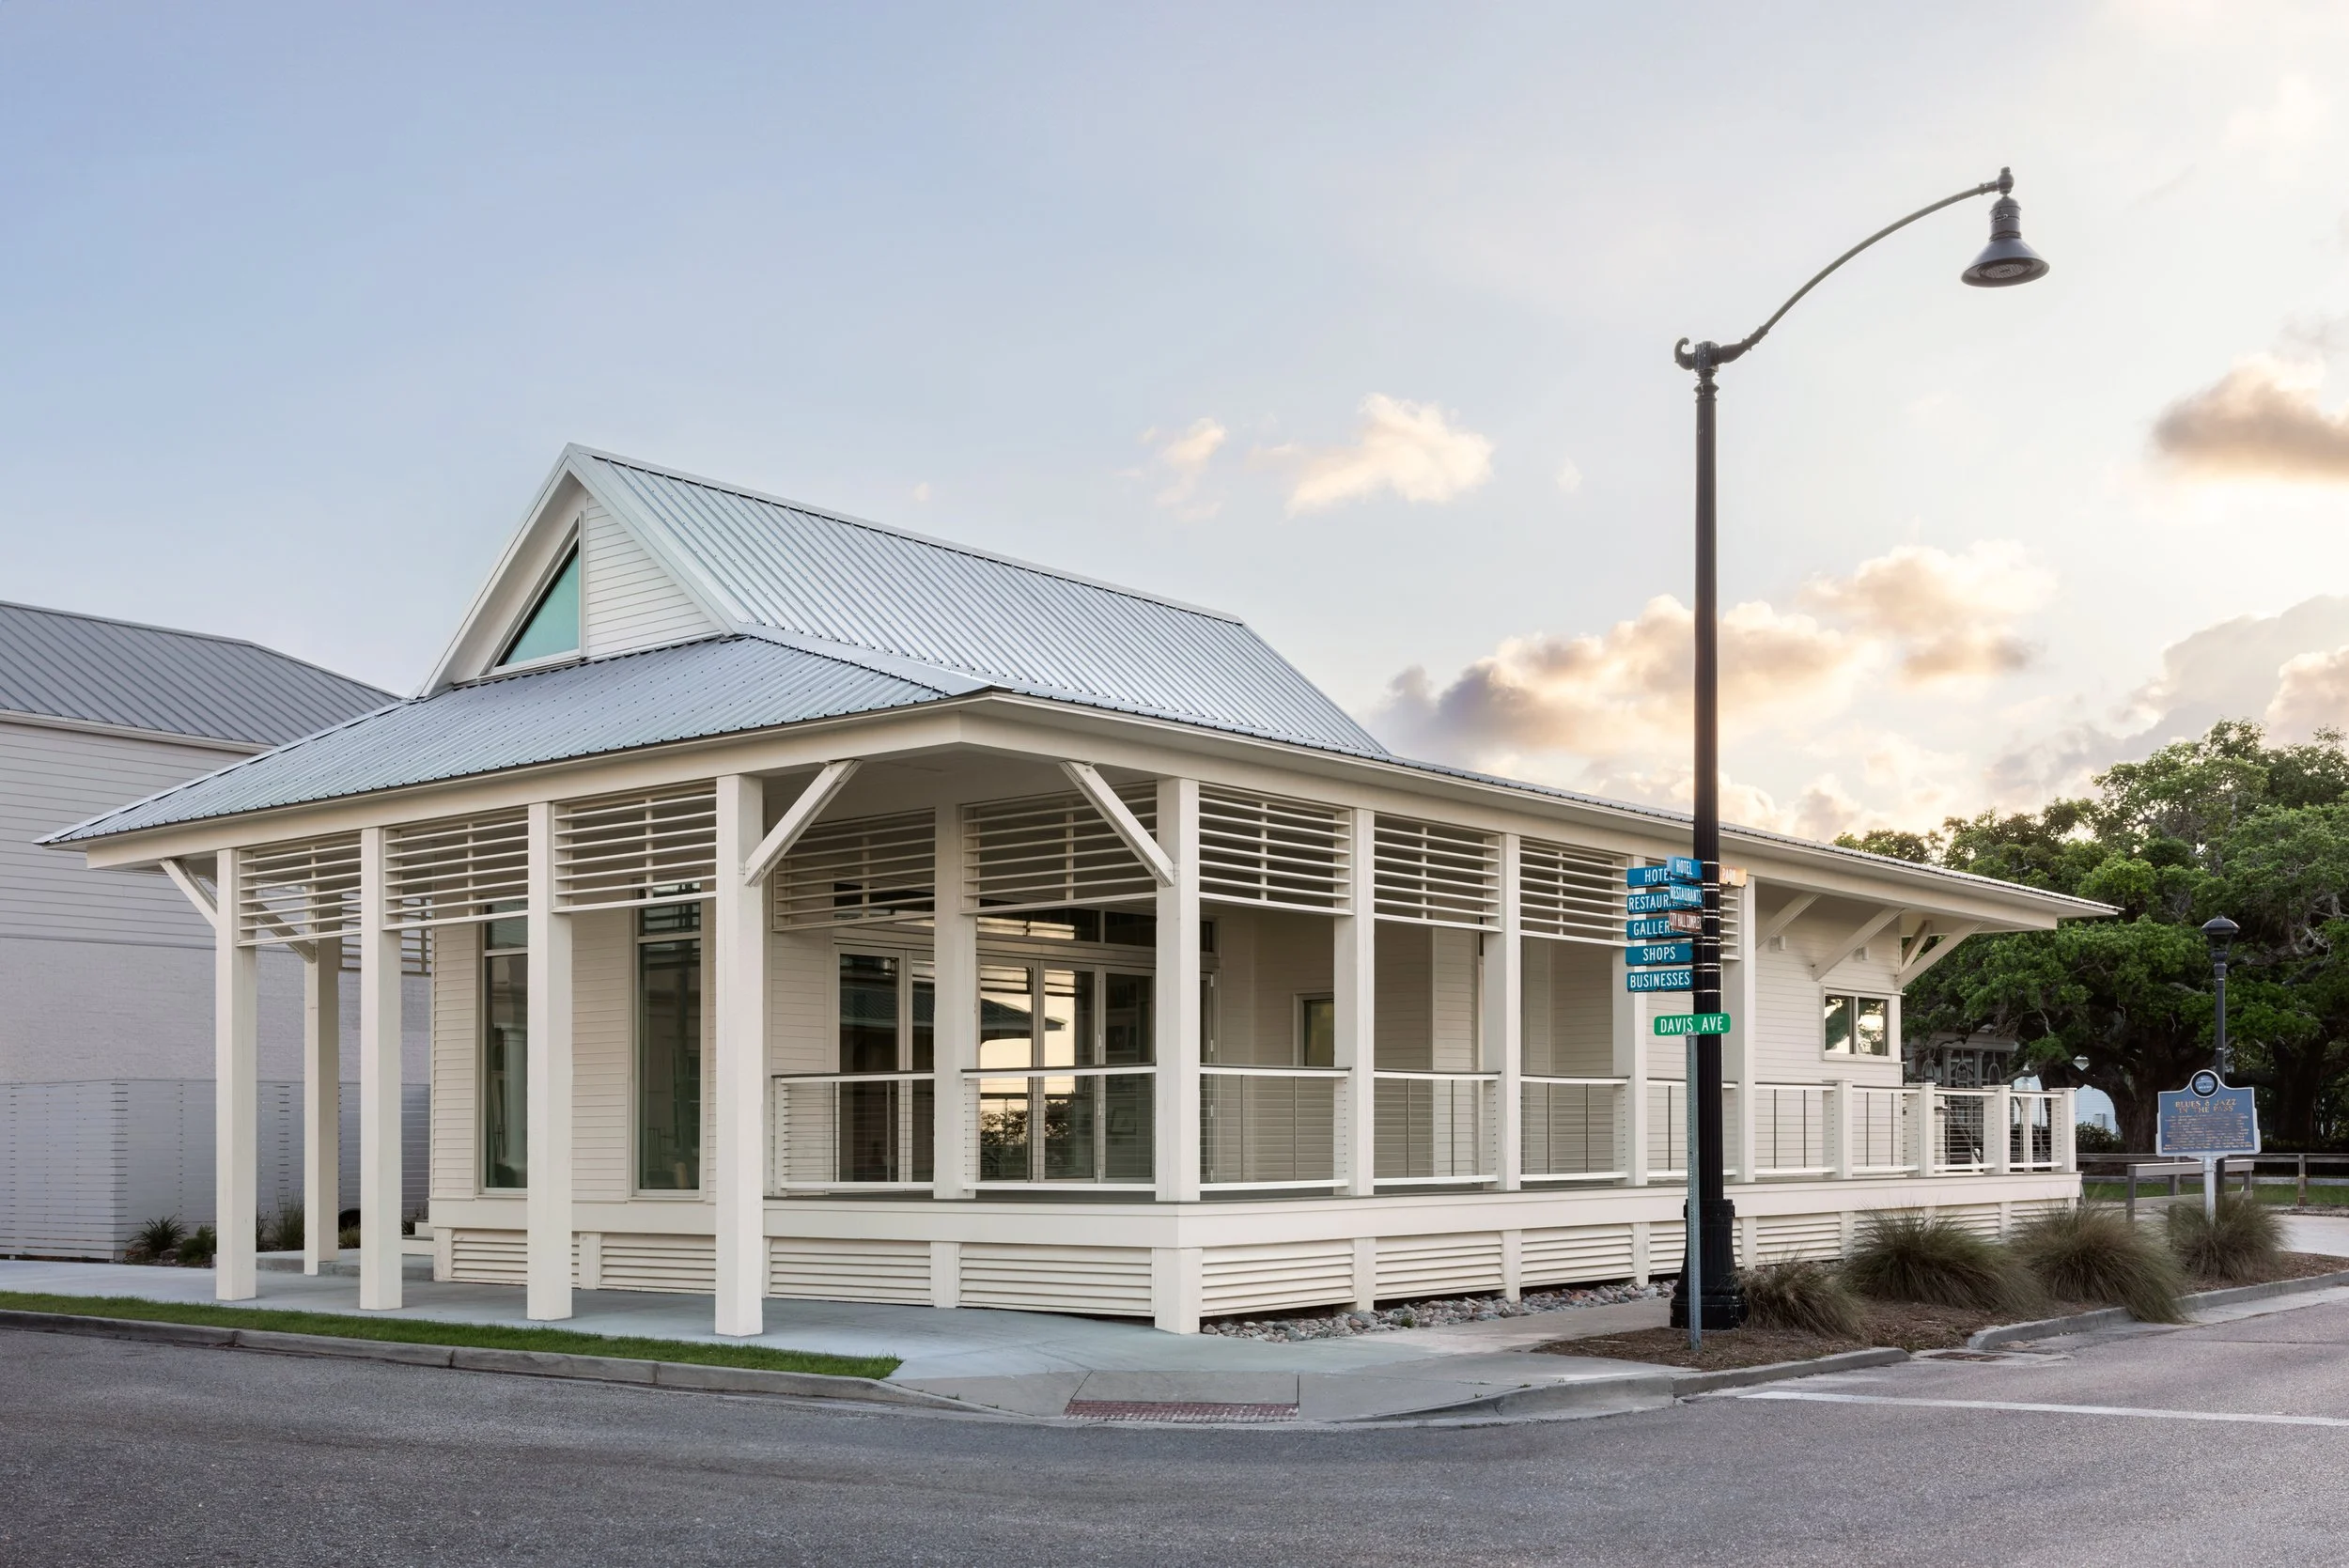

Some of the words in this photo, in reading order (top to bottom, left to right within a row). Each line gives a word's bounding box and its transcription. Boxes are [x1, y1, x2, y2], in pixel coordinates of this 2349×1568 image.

[1675, 859, 1693, 875] HOTEL
[1628, 894, 1677, 910] RESTAUR
[1671, 885, 1702, 903] RESTAURANTS
[1633, 921, 1674, 936] GALLER
[1677, 914, 1687, 928] HALL
[1642, 946, 1676, 961] SHOPS
[1630, 971, 1690, 988] BUSINESSES
[1660, 1017, 1693, 1032] DAVIS
[1702, 1016, 1724, 1032] AVE
